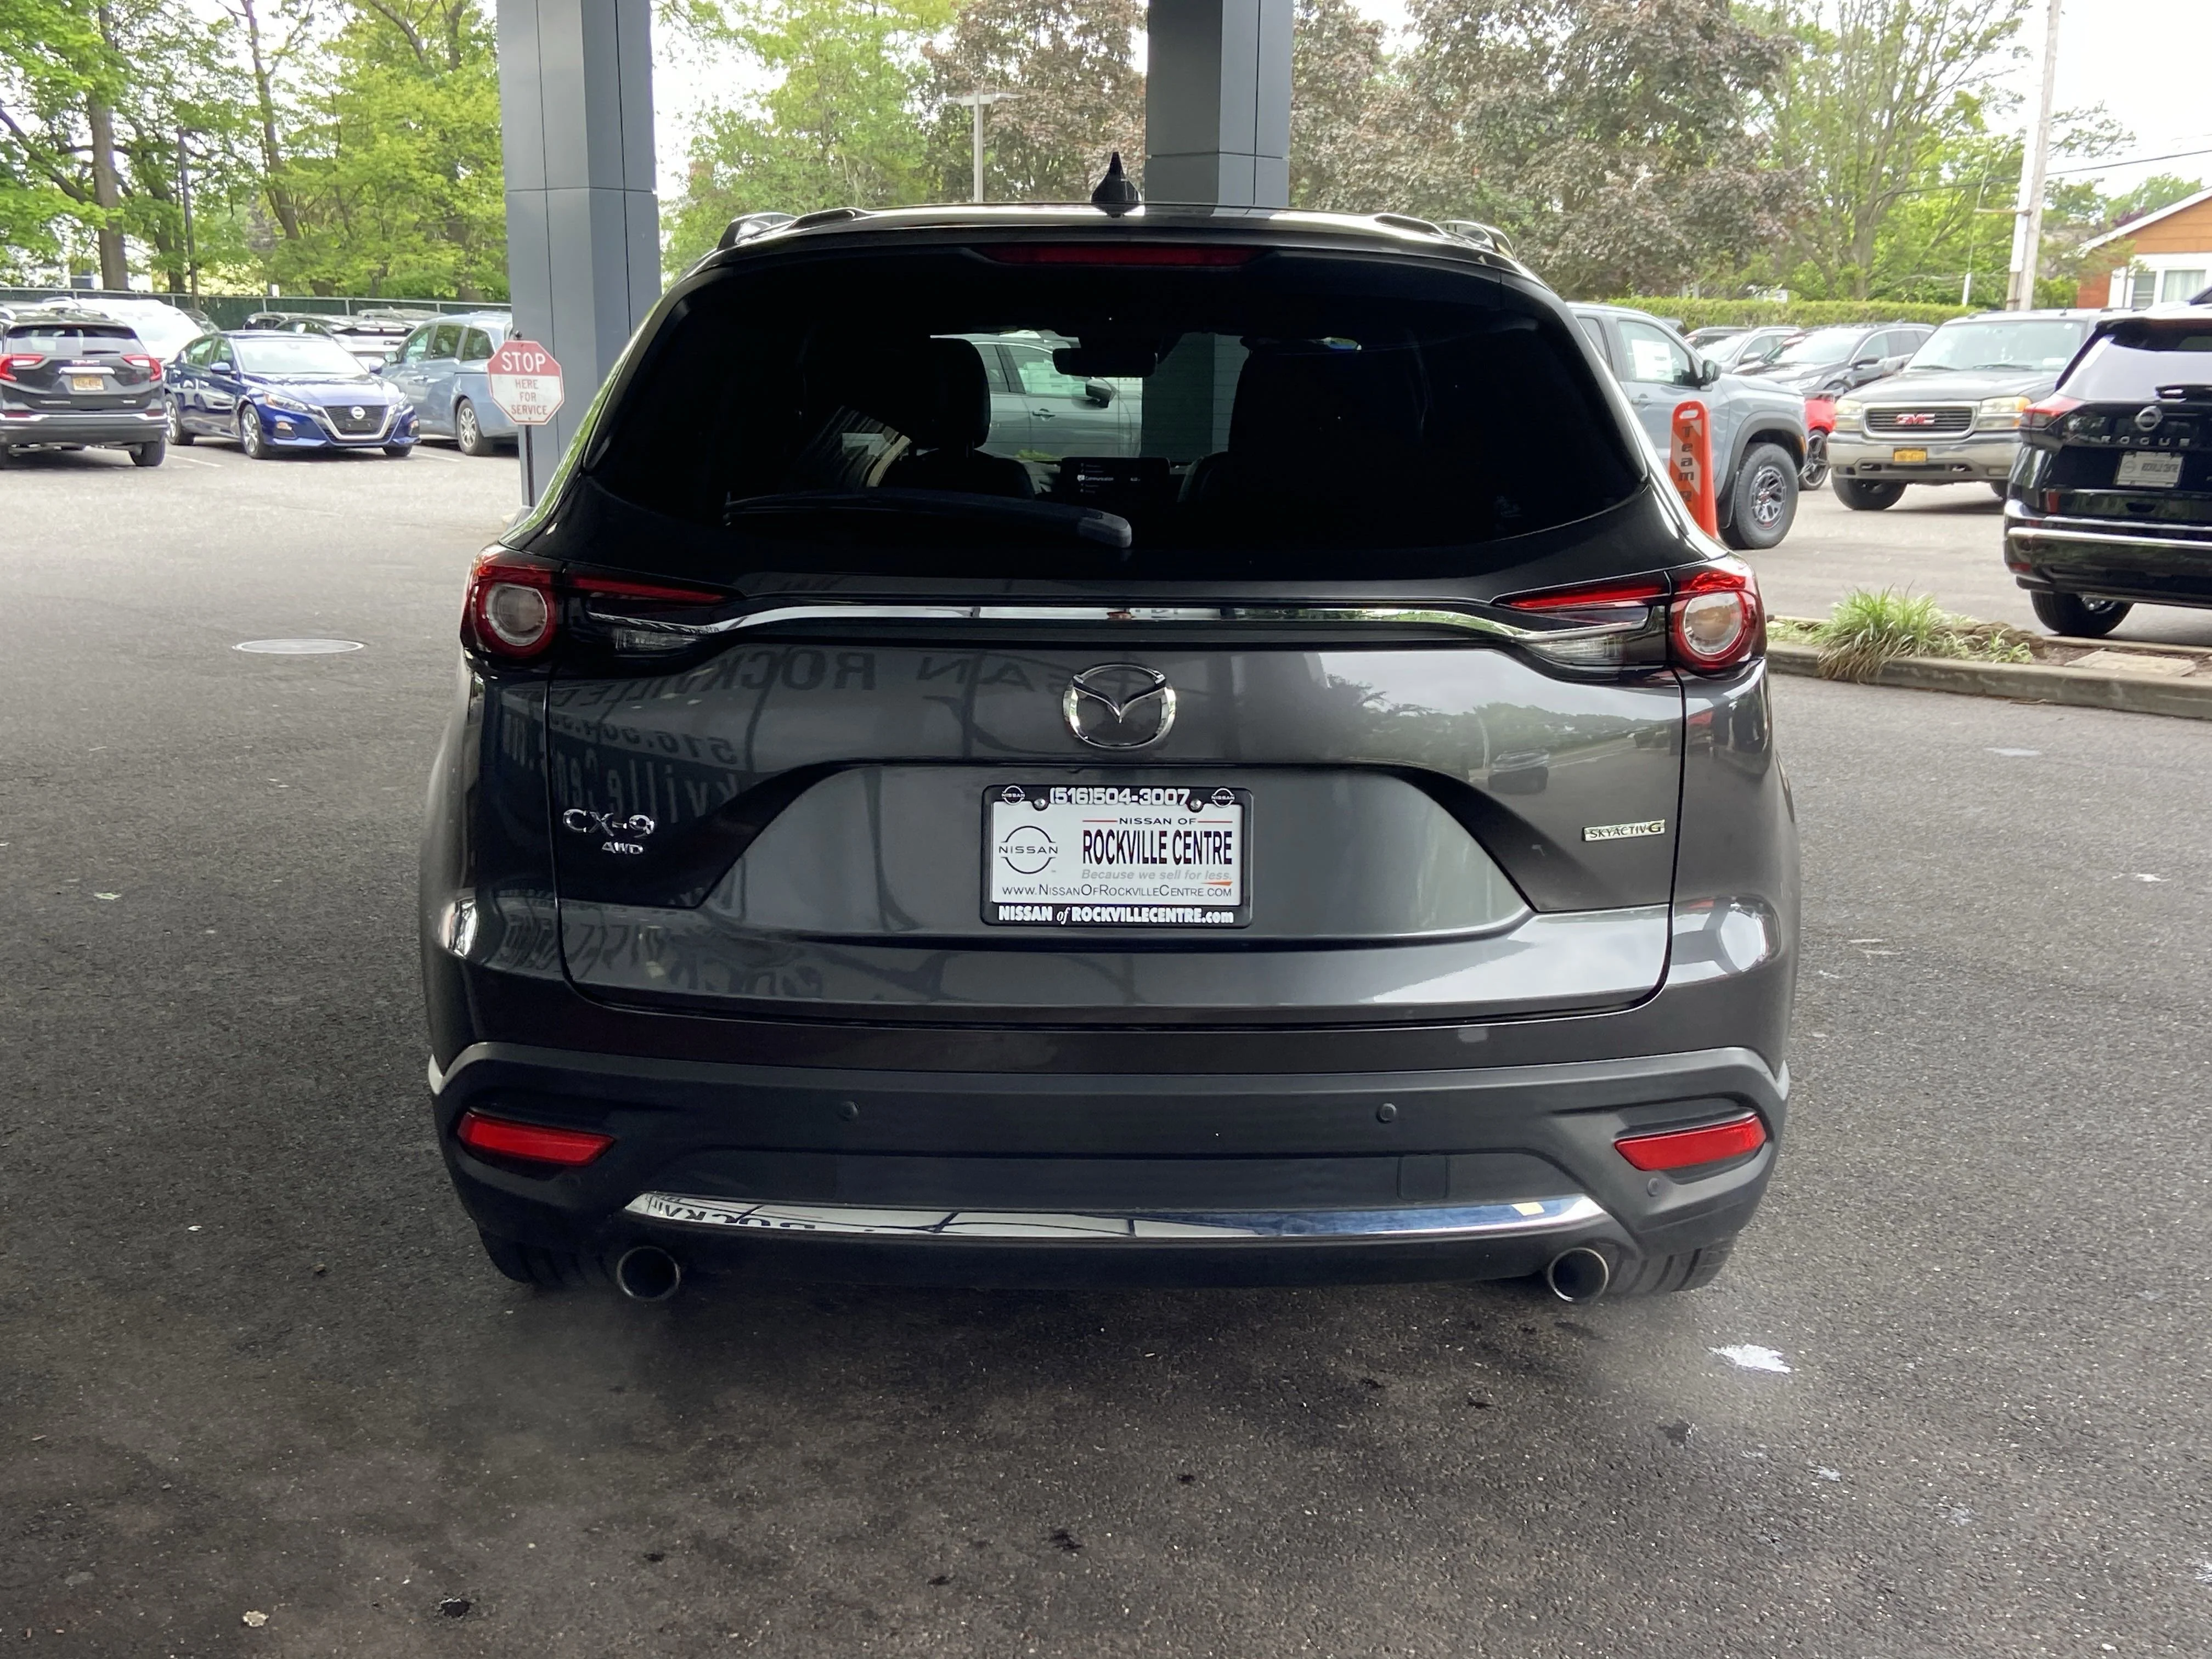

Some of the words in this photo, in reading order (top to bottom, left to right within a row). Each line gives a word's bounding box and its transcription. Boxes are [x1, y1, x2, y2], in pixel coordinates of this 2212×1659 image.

[501, 351, 546, 373] STOP
[515, 379, 539, 389] HERE
[520, 392, 537, 402] FOR
[511, 405, 548, 415] SERVICE
[1049, 787, 1191, 805] (516)504-3007
[563, 809, 655, 838] CX-9
[601, 842, 644, 854] AWD
[1083, 829, 1167, 865] ROCKVILLE
[1172, 830, 1233, 865] CENTRE
[1081, 868, 1135, 879] Because
[1139, 871, 1155, 879] we
[1160, 870, 1181, 880] sell
[1184, 870, 1201, 880] for
[1205, 870, 1232, 881] less.
[998, 905, 1053, 921] NISSAN
[1056, 907, 1070, 924] of
[1071, 906, 1234, 923] ROCKVILLECENTRE.com
